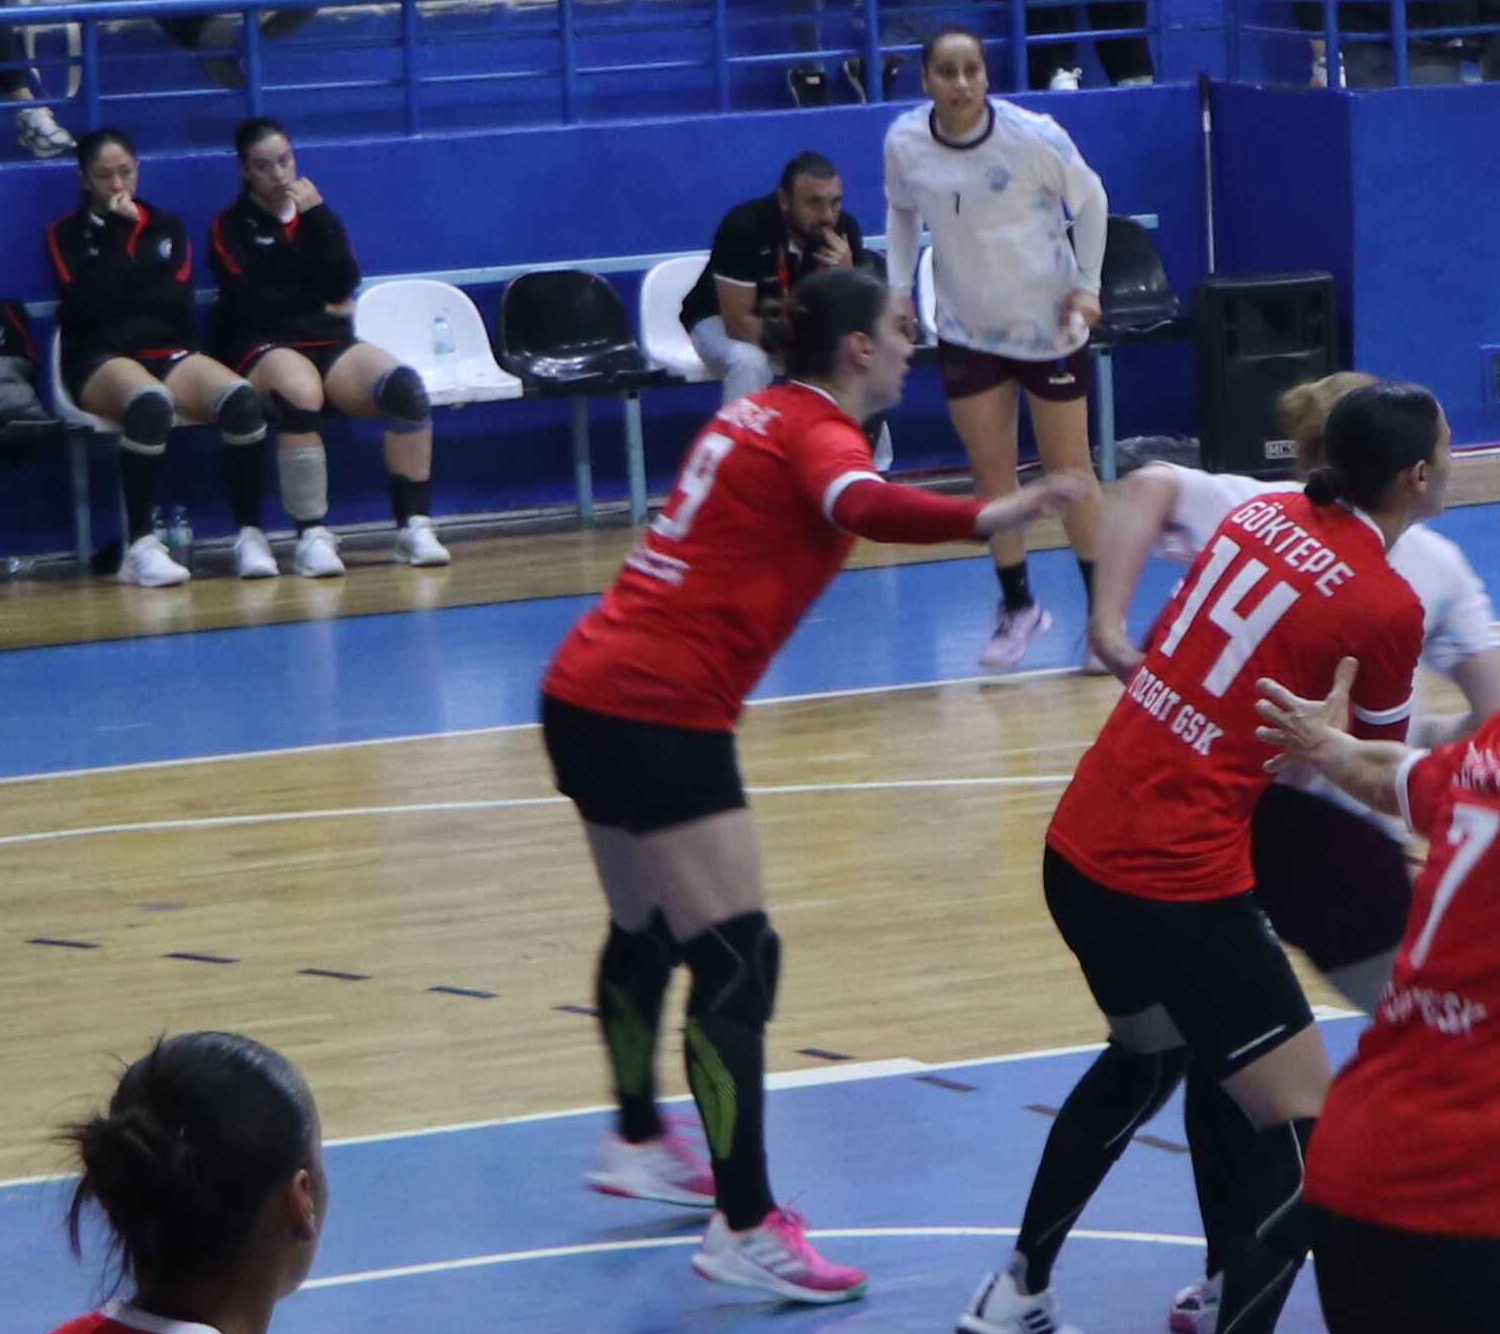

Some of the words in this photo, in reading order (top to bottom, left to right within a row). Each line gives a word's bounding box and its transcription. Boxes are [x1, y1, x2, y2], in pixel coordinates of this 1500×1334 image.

[1230, 500, 1355, 598] GÖKTEPE
[1159, 534, 1301, 700] 14
[1170, 704, 1226, 757] GSK
